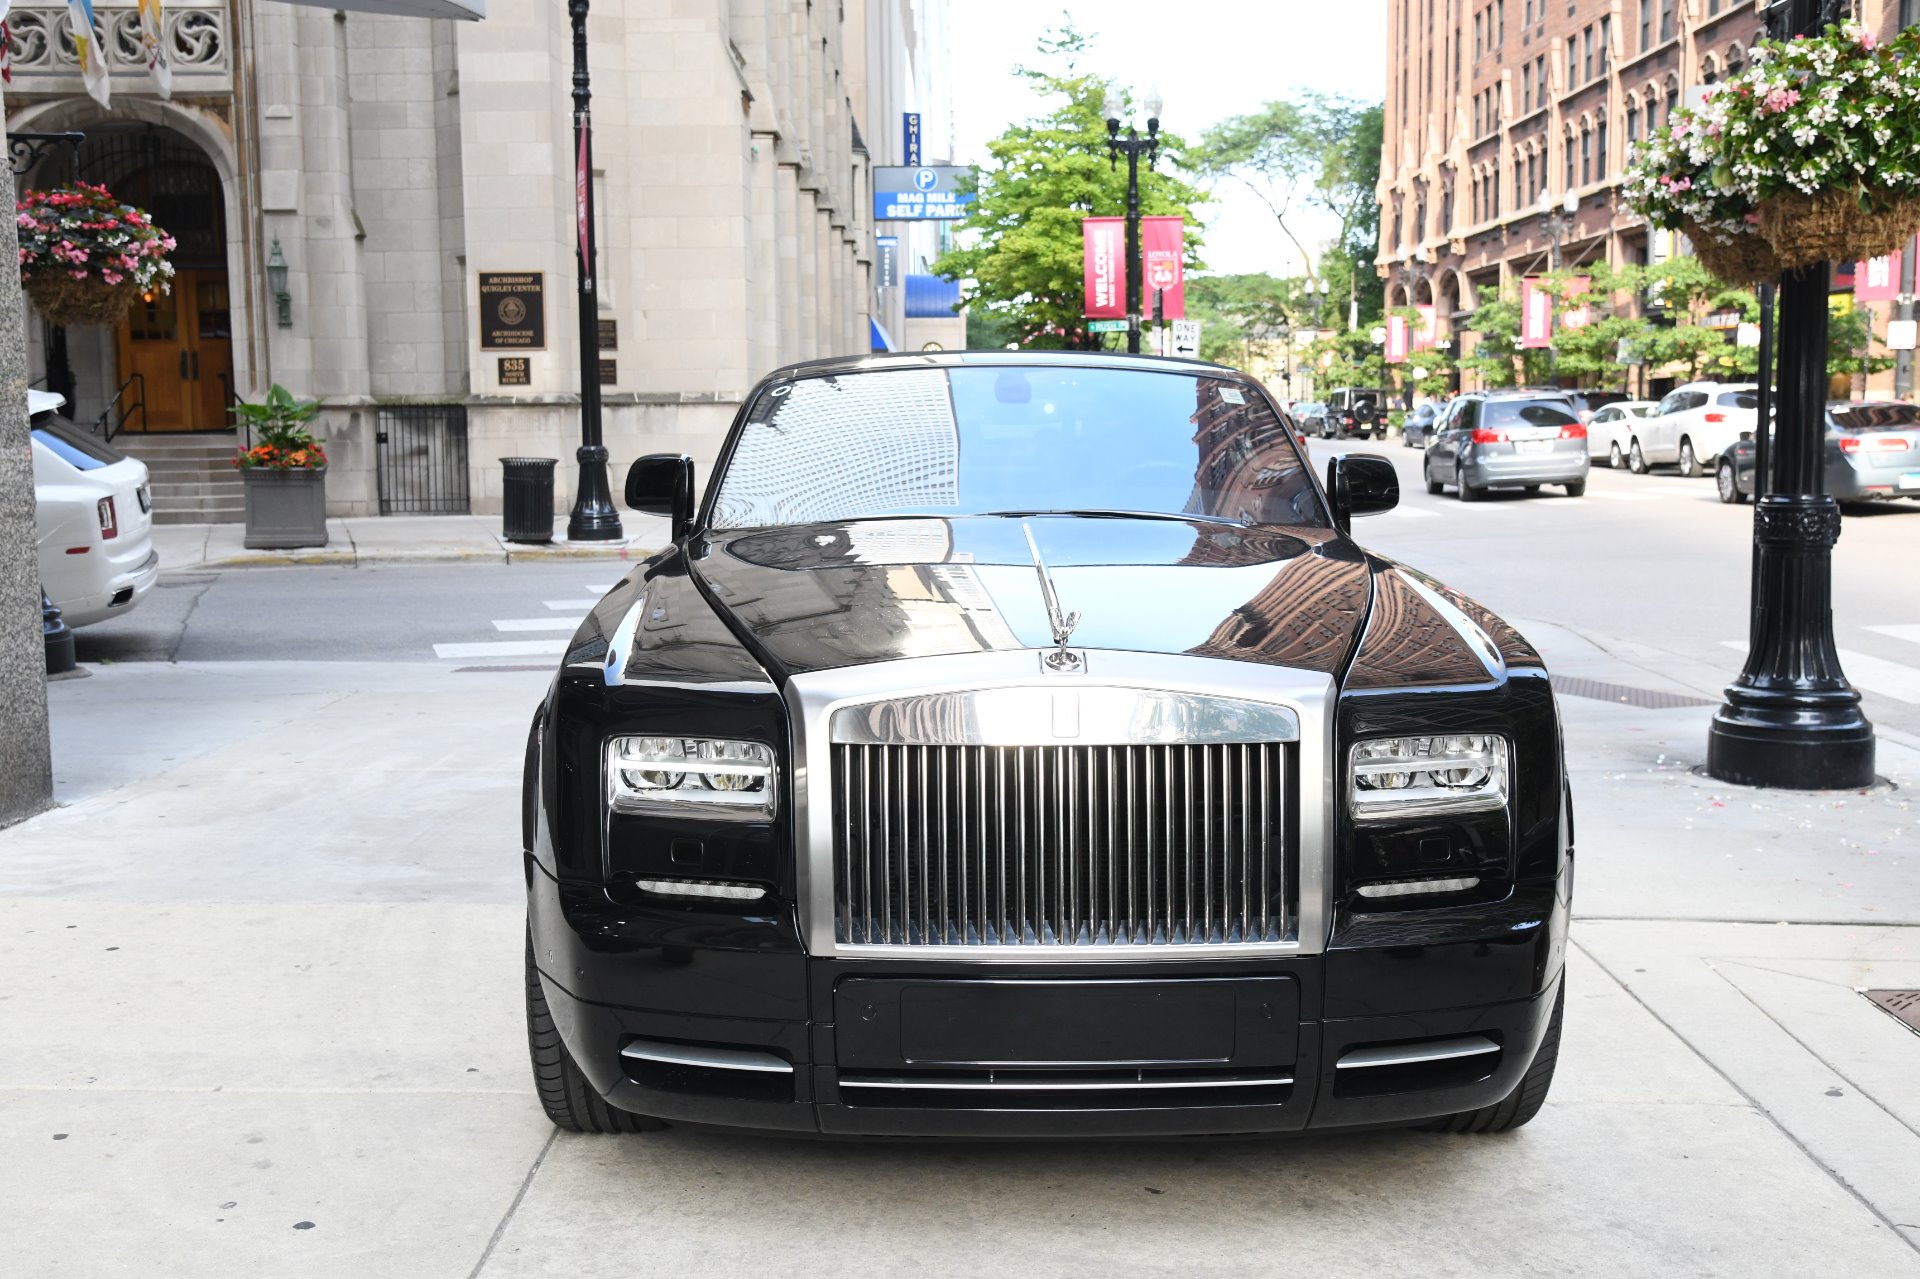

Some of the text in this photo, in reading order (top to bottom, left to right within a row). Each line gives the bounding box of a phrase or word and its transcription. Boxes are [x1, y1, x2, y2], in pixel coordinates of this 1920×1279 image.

[897, 192, 956, 203] MAG MILE
[886, 204, 923, 217] SELF
[1094, 230, 1109, 307] WELCOME
[481, 285, 512, 293] QUIGLEY
[1176, 324, 1195, 332] ONE
[1175, 335, 1196, 343] WAY
[504, 359, 525, 371] 835
